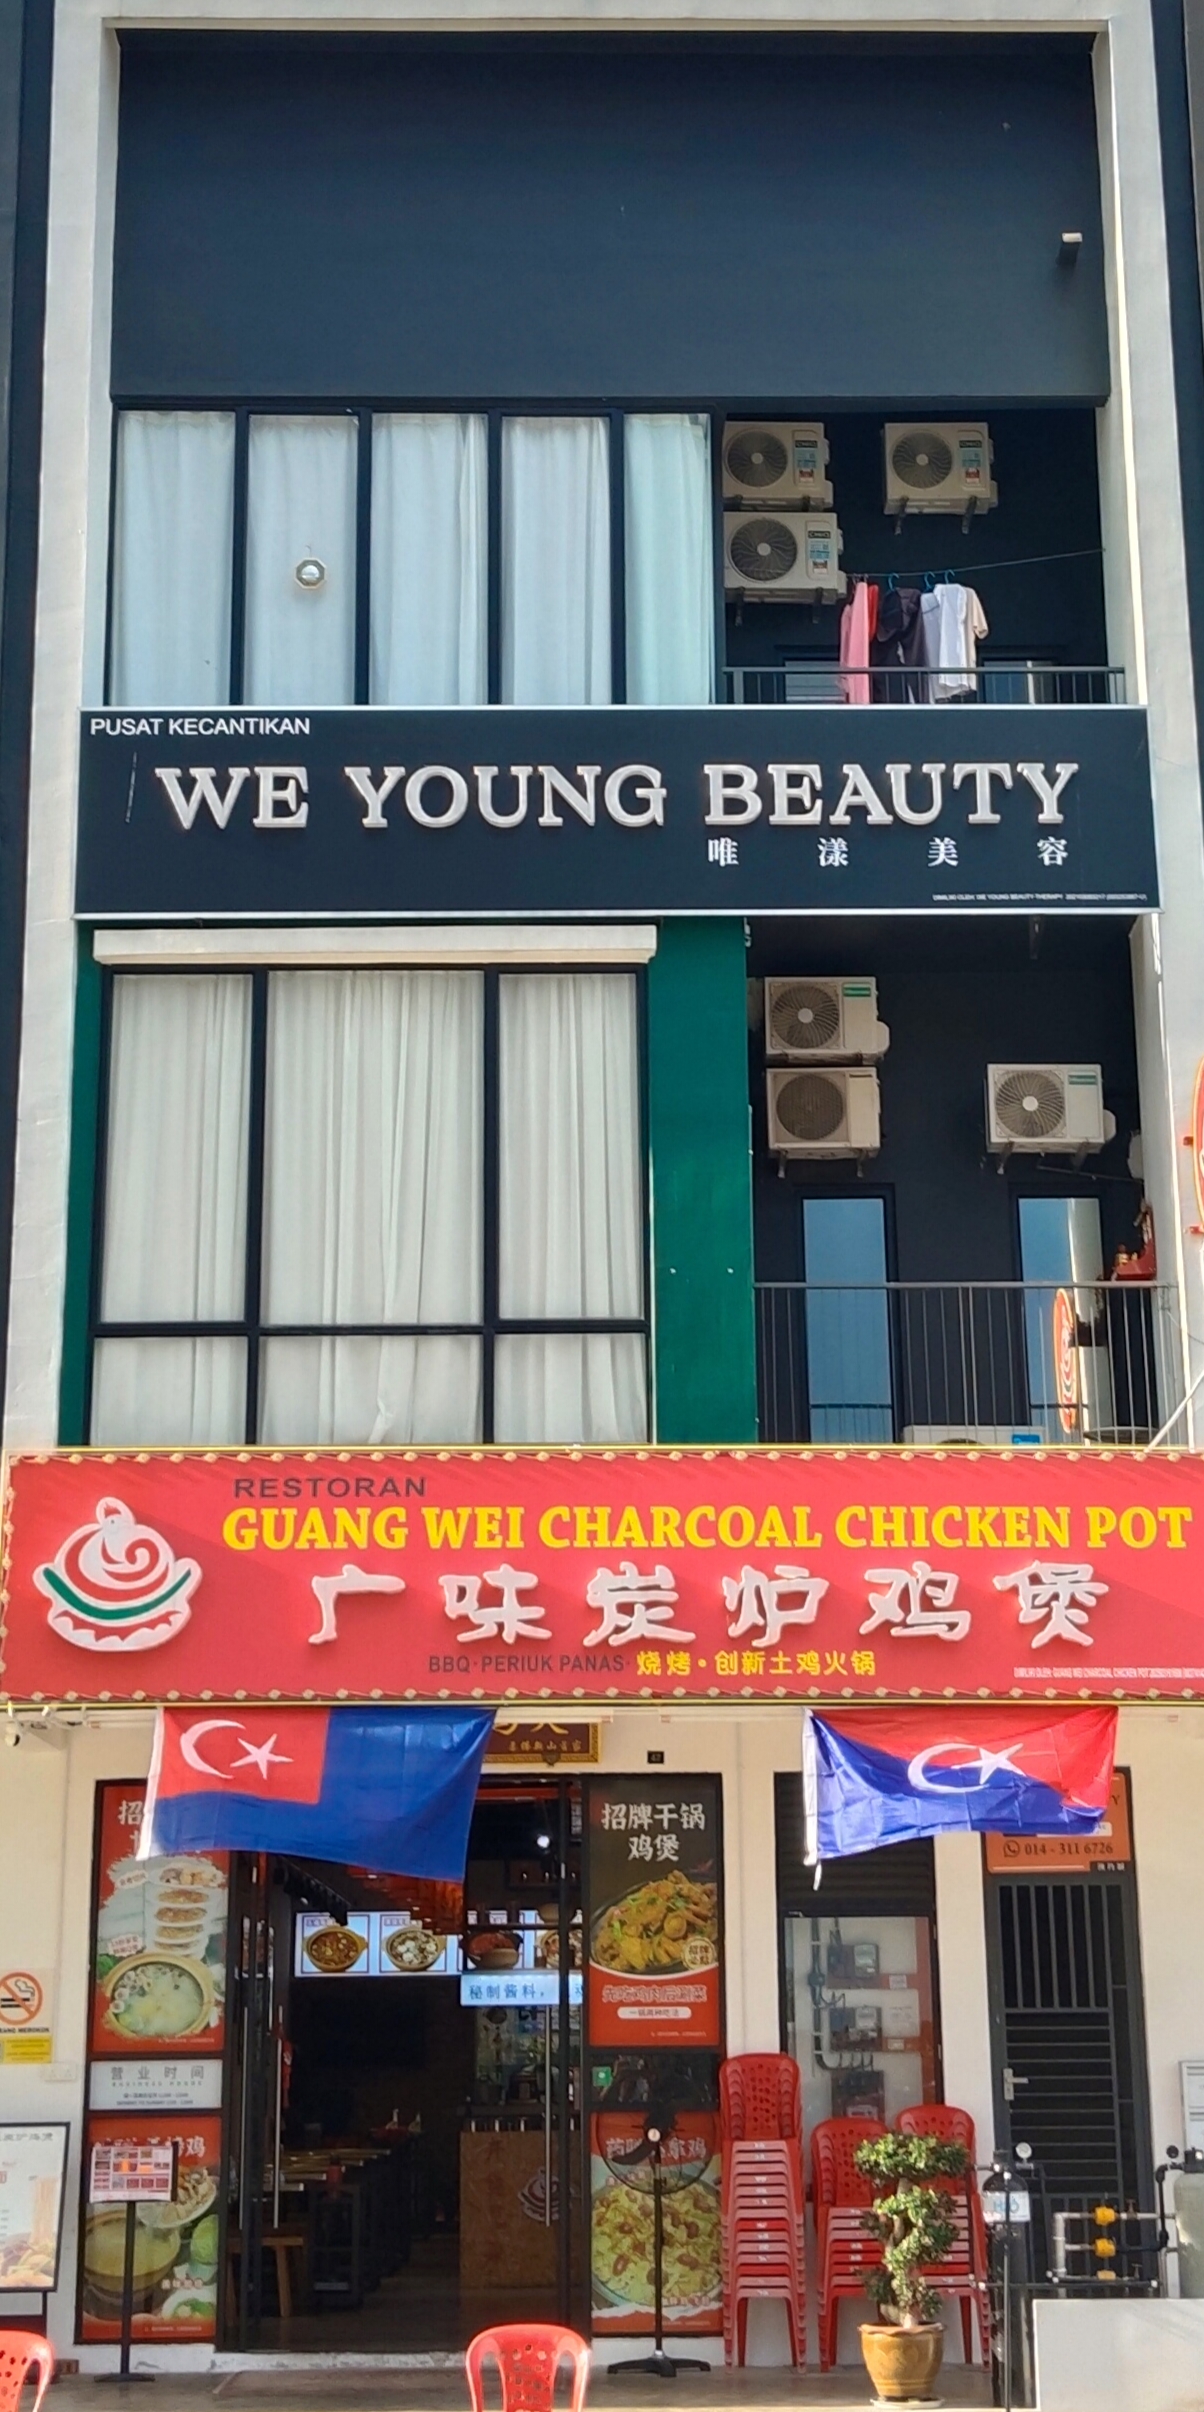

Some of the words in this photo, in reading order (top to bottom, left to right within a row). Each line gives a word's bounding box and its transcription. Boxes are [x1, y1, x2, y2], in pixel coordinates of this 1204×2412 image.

[90, 719, 163, 736] PUSAT
[168, 718, 310, 736] KECANTIKAN
[154, 766, 309, 830] WE
[344, 764, 668, 828] YOUNG
[703, 763, 1079, 826] BEAUTY
[234, 1477, 426, 1499] RESTORAN
[222, 1507, 409, 1550] GUANG
[420, 1506, 521, 1550] WEI
[538, 1505, 823, 1549] CHARCOAL
[834, 1505, 1072, 1549] CHICKEN
[1087, 1505, 1193, 1549] POT
[308, 1560, 1110, 1649] 广味炭炉鸡煲
[600, 1803, 706, 1831] 招牌干锅
[627, 1833, 681, 1862] 鸡煲
[1024, 1842, 1046, 1855] 014
[1059, 1842, 1080, 1855] 311
[1084, 1842, 1114, 1855] 6726
[111, 2065, 204, 2080] 营业时间
